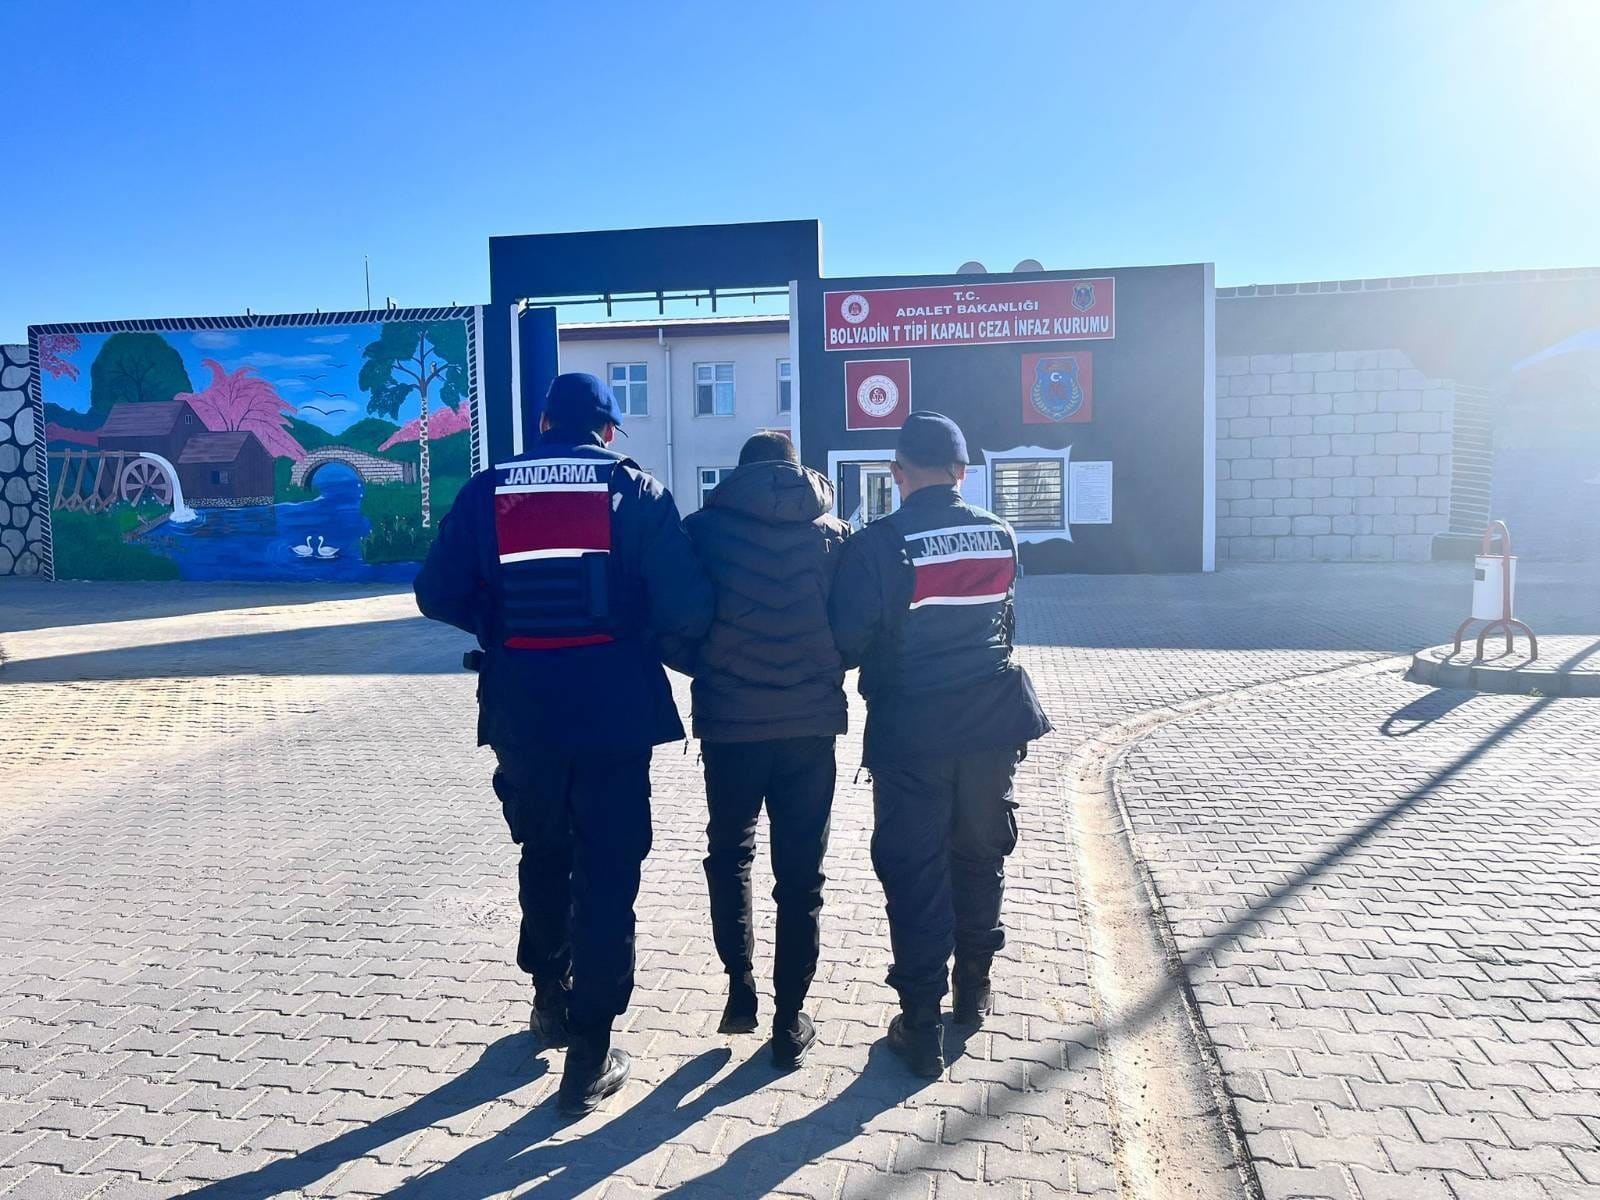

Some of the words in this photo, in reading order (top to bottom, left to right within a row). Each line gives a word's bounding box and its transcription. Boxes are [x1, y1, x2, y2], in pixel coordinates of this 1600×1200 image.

[953, 291, 980, 302] T.C.
[896, 305, 953, 318] ADALET
[957, 299, 1039, 315] BAKANLIĞI
[830, 322, 889, 345] BOLVADİN
[893, 325, 900, 342] T
[904, 320, 927, 341] TİPİ
[931, 322, 974, 340] KAPALI
[978, 320, 1011, 338] CEZA
[1014, 316, 1050, 336] İNFAZ
[1054, 316, 1109, 335] KURUMU
[505, 464, 598, 485] JANDARMA
[921, 531, 1002, 556] JANDARMA
